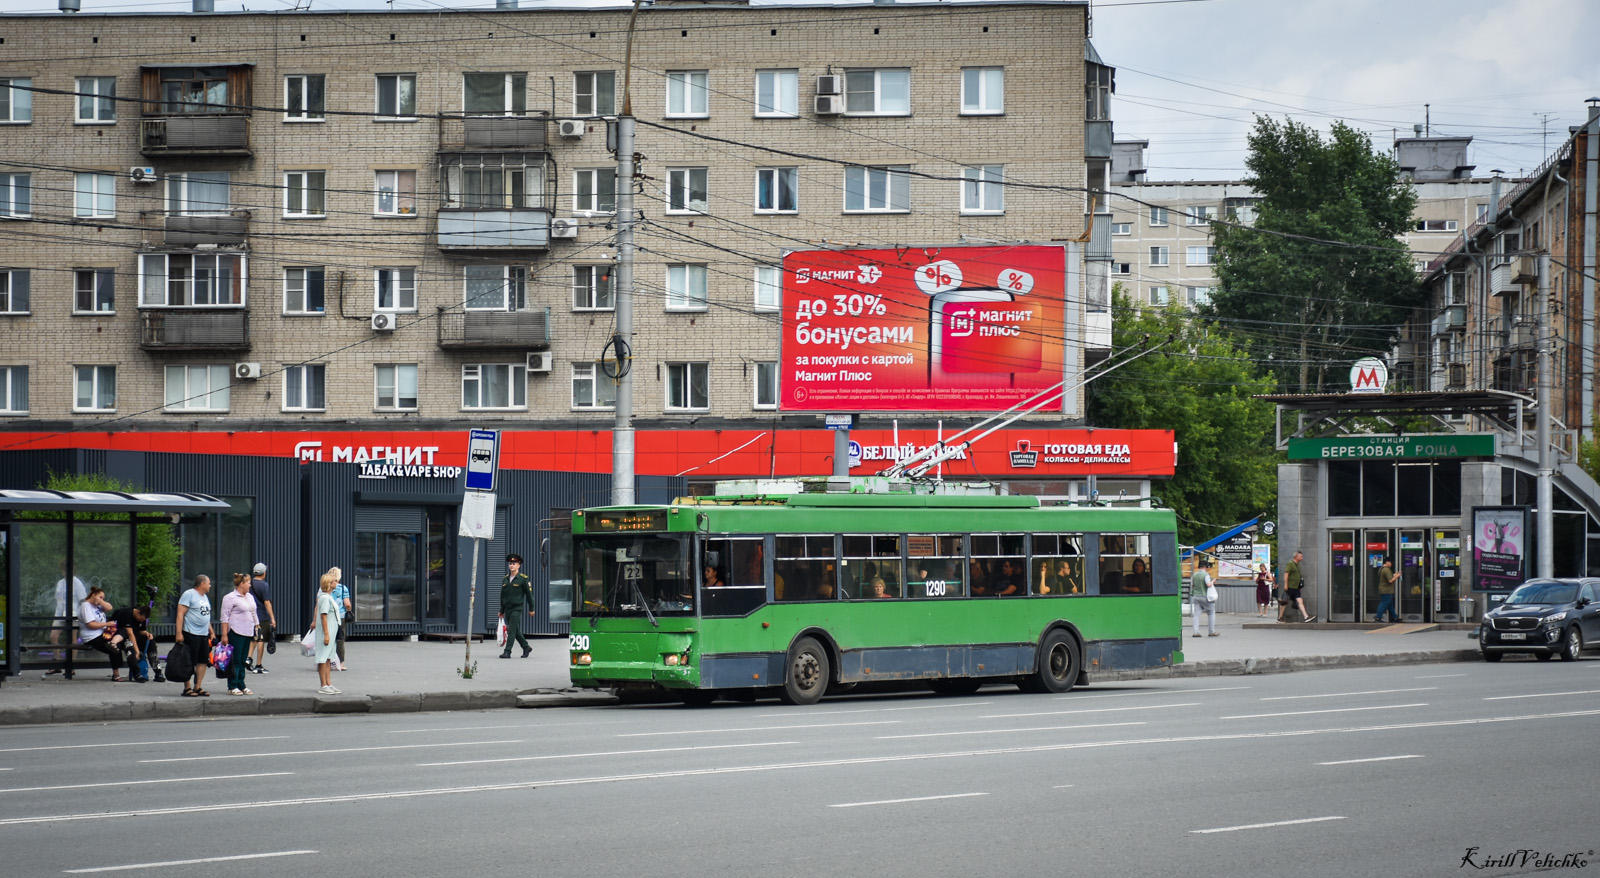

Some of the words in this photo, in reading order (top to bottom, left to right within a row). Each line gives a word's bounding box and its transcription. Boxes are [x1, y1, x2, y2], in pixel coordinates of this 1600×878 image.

[812, 270, 855, 280] МАГНИТ
[796, 300, 828, 320] до
[833, 294, 886, 316] 30%
[796, 322, 914, 350] бонусами
[796, 356, 809, 365] за
[812, 356, 860, 368] покупки
[862, 356, 870, 364] с
[872, 352, 914, 366] картой
[796, 370, 837, 381] Магнит
[840, 370, 872, 381] Плюс
[1356, 368, 1380, 388] М
[796, 390, 804, 399] 6+
[332, 447, 438, 465] МАГНИТ
[1044, 444, 1102, 454] ГОТОВАЯ
[1105, 444, 1130, 456] ЕДА
[1322, 446, 1404, 457] БЕРЕЗОВАЯ
[1416, 445, 1458, 456] РОЩА
[360, 464, 431, 478] ТАБАК&VAPE
[433, 466, 462, 478] SHOP
[626, 568, 640, 578] 22
[926, 580, 946, 596] 1290
